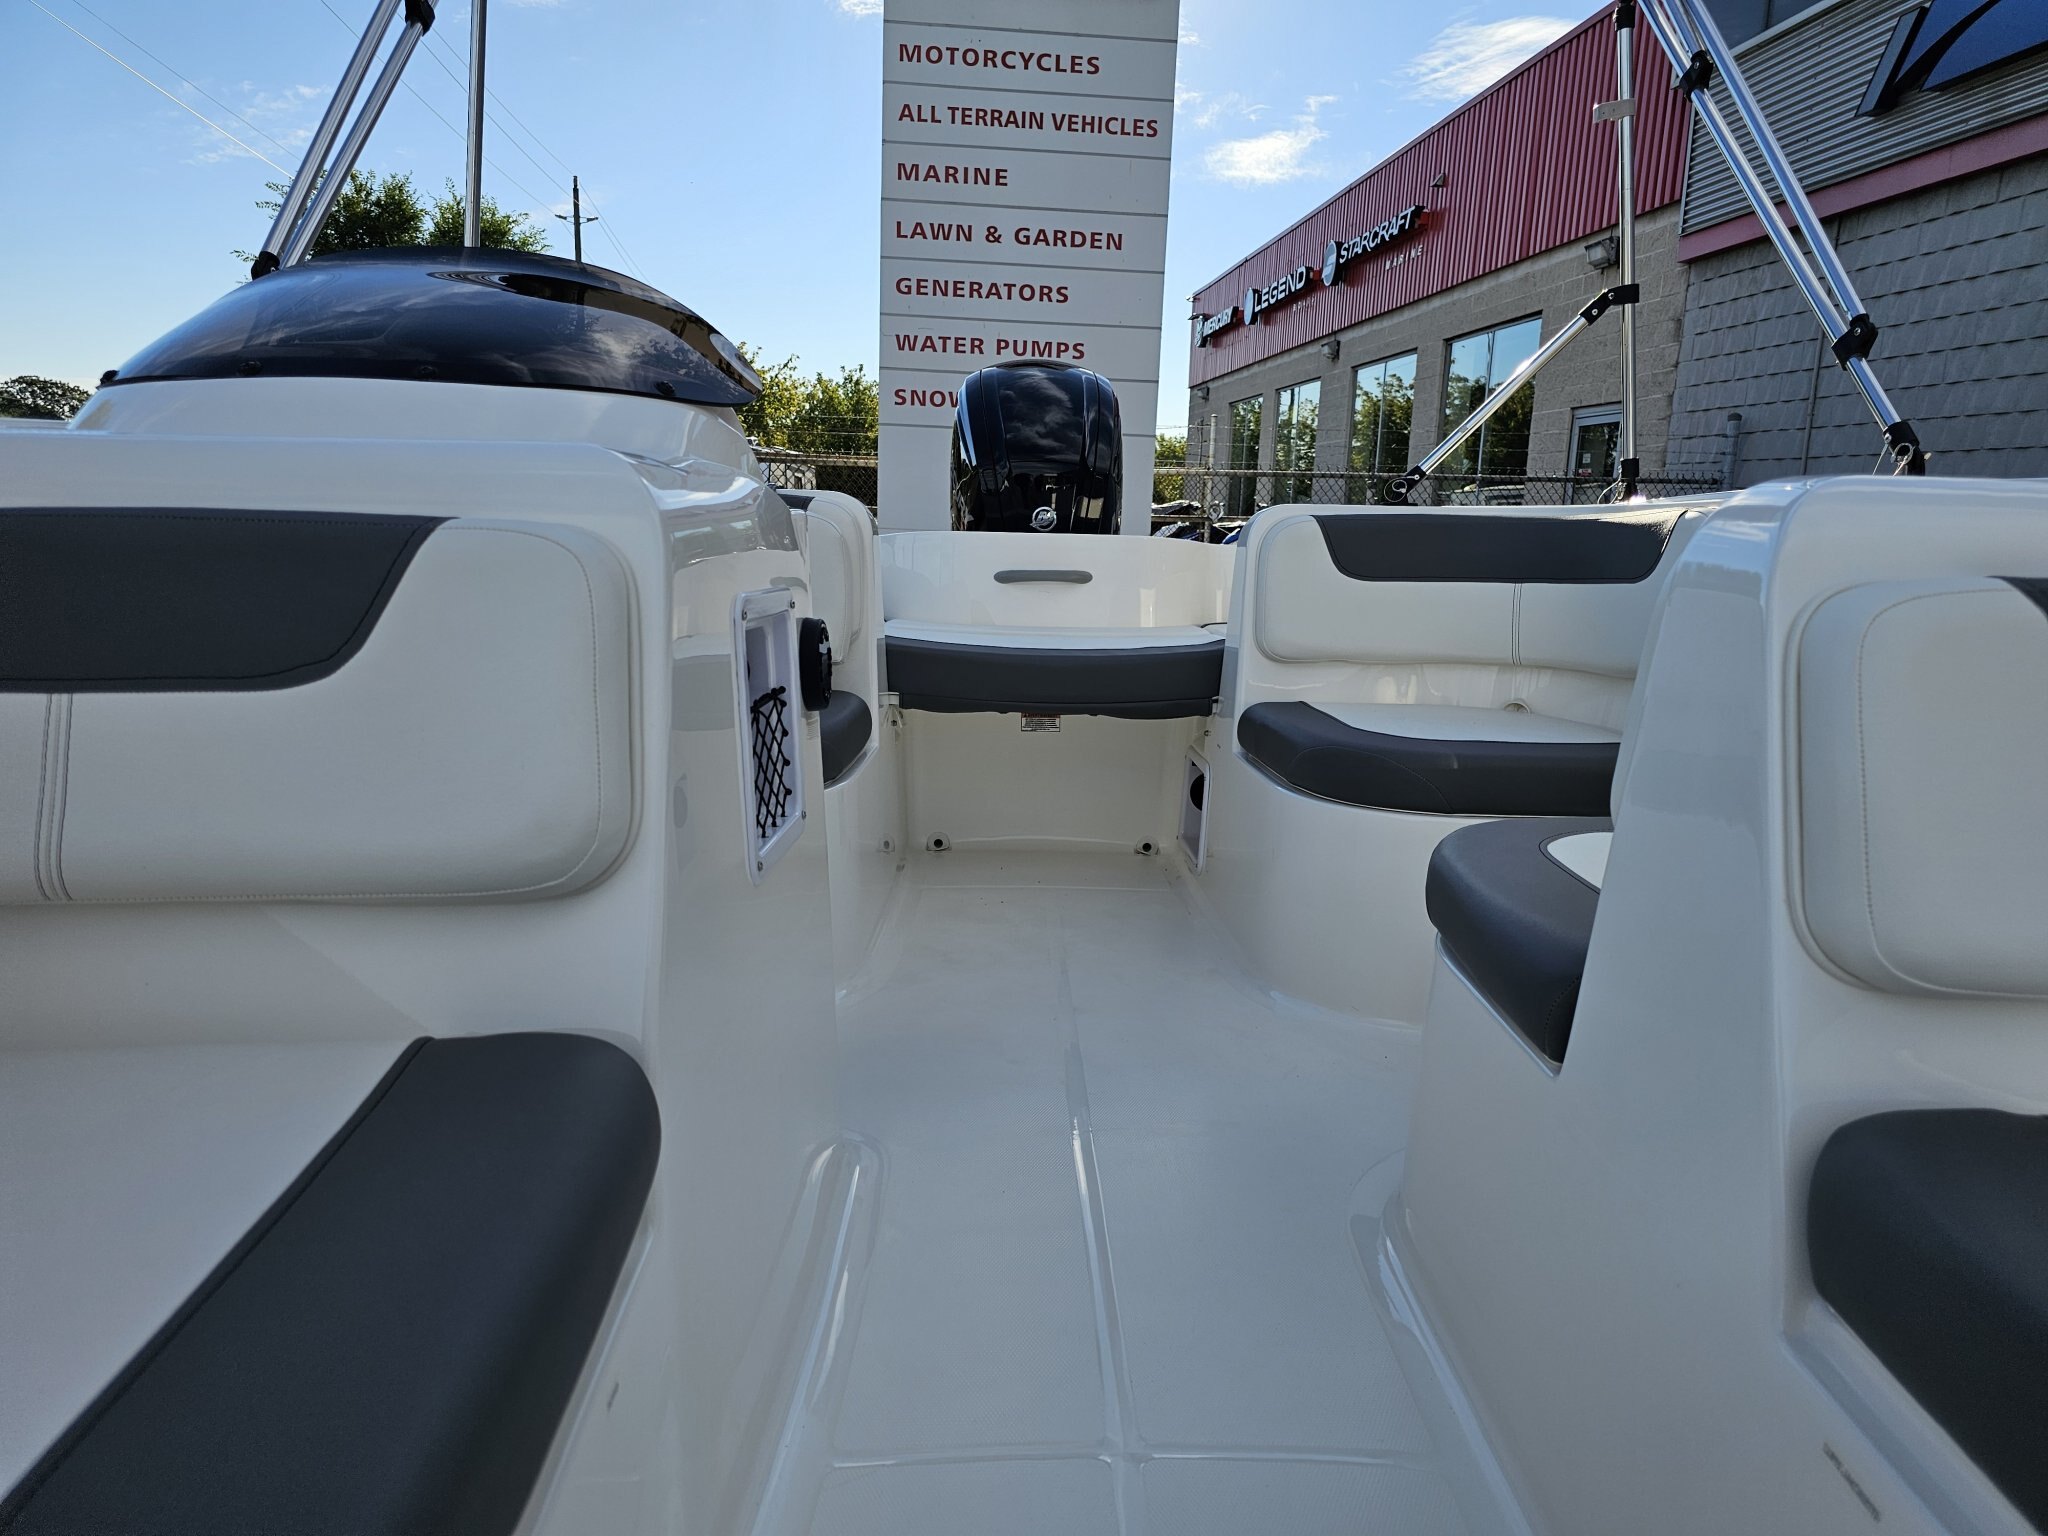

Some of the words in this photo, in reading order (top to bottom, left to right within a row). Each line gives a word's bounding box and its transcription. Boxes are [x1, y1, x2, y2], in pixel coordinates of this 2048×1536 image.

[899, 43, 1100, 75] MOTORCYCLES
[898, 103, 942, 124] ALL
[947, 106, 1044, 131] TERRAIN
[1051, 113, 1159, 138] VEHICLES
[897, 162, 1009, 187] MARINE
[895, 221, 973, 243] LAWN
[985, 225, 1002, 244] &
[1014, 227, 1124, 251] GARDEN
[1339, 205, 1415, 264] STARCRAFT
[895, 277, 1069, 304] GENERATORS
[1254, 265, 1306, 313] LEGEND
[895, 333, 985, 355] WATER
[996, 338, 1086, 360] PUMPS
